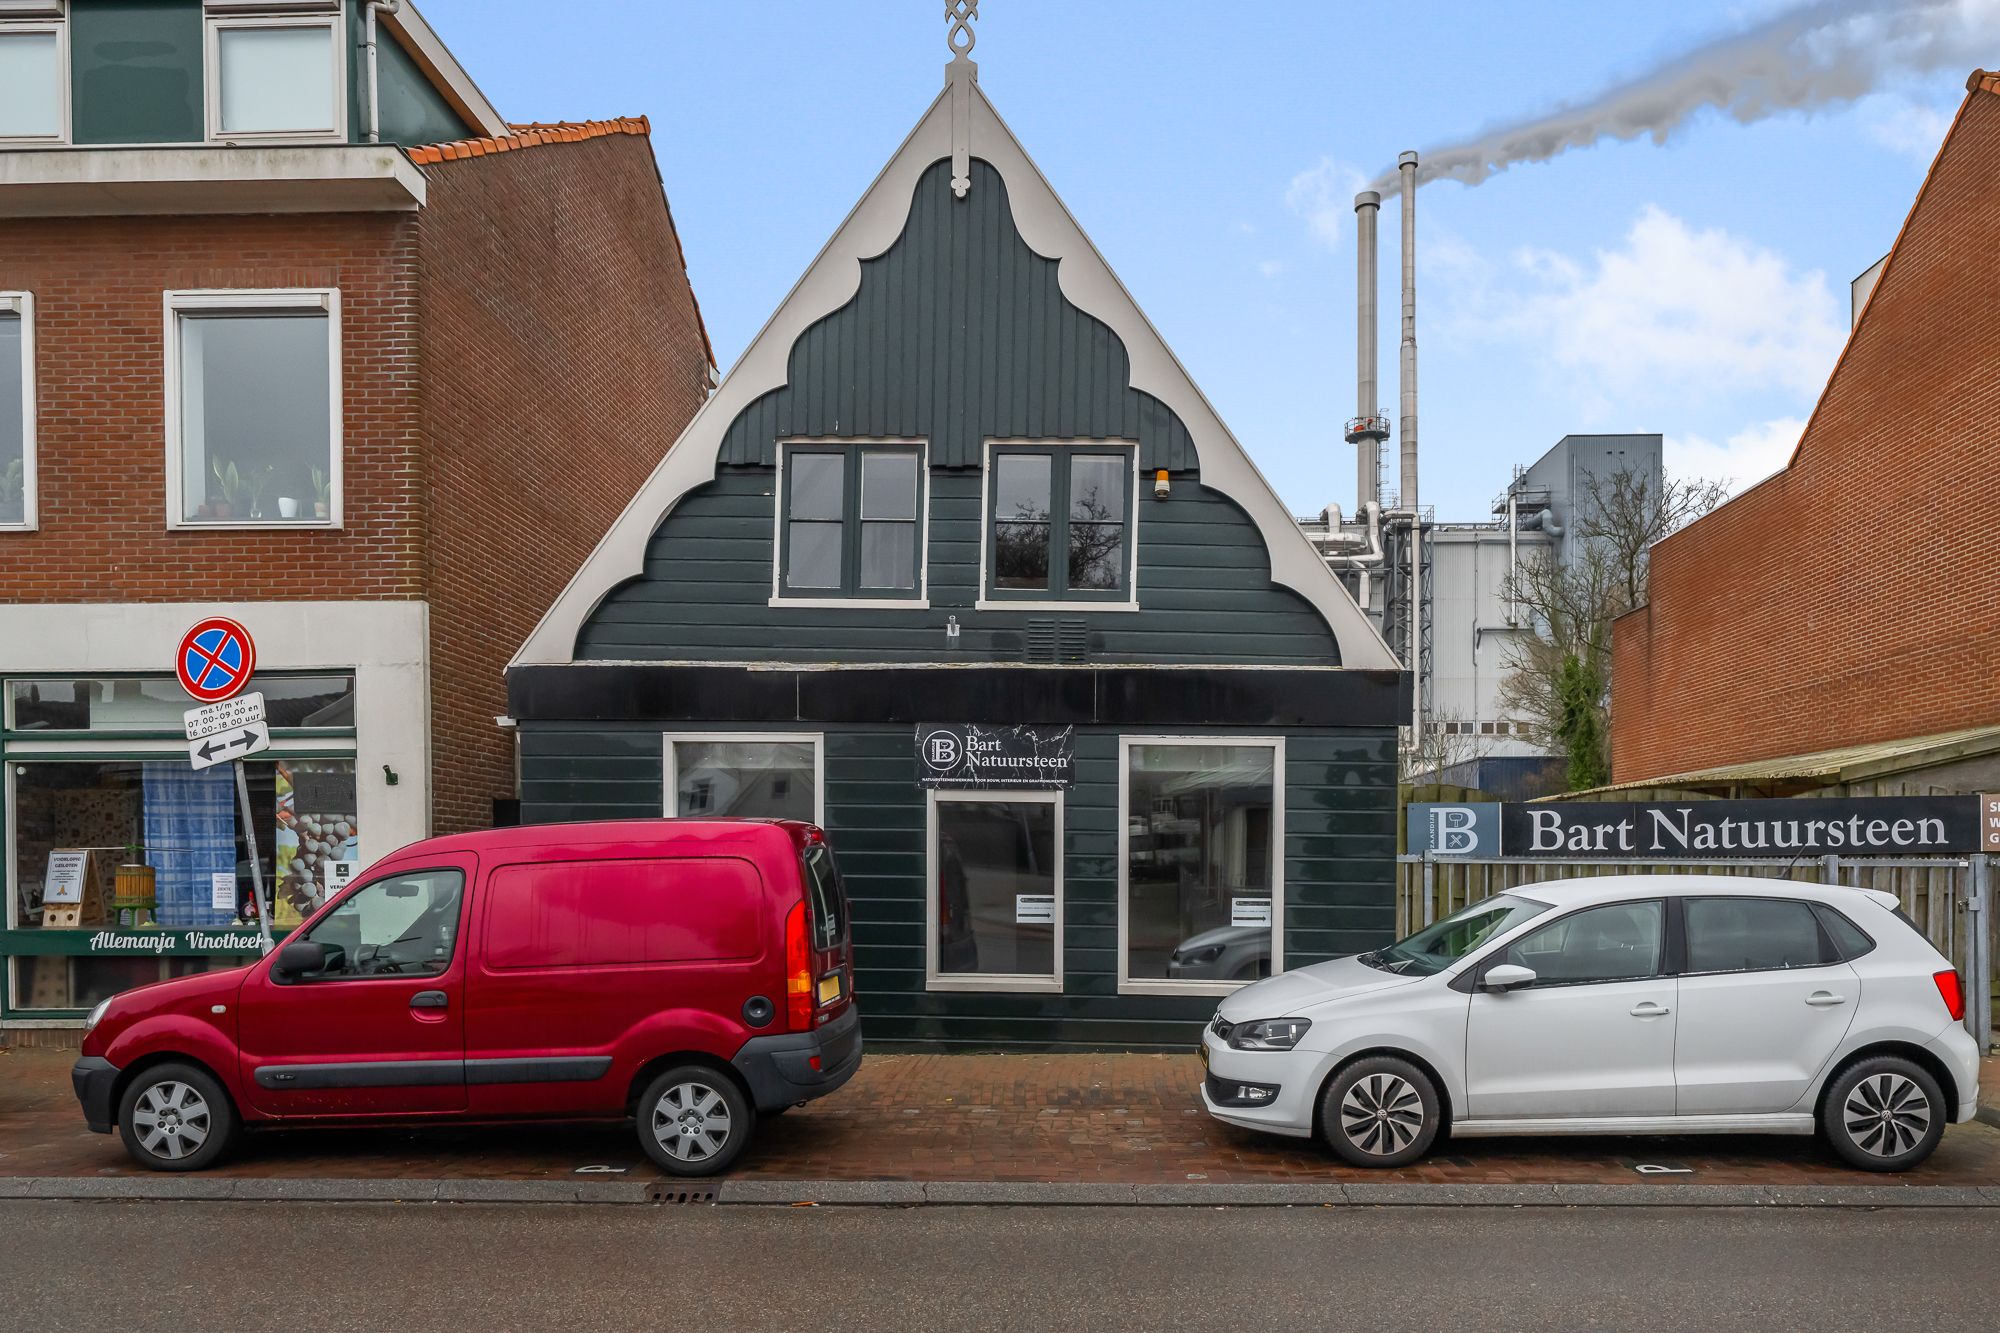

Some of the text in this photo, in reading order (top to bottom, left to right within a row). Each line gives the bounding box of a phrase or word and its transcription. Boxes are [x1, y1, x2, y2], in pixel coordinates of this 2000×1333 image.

[188, 704, 259, 728] 07.00-09.00 en
[216, 703, 232, 712] t/m
[189, 713, 260, 737] 16.00-18.00 uur
[965, 735, 1002, 751] Bart
[965, 751, 1068, 768] Natuursteen
[1526, 810, 1634, 851] Bart
[1647, 808, 1949, 850] Natuursteen
[89, 931, 176, 954] Allemanja
[185, 931, 264, 950] Vinotheek
